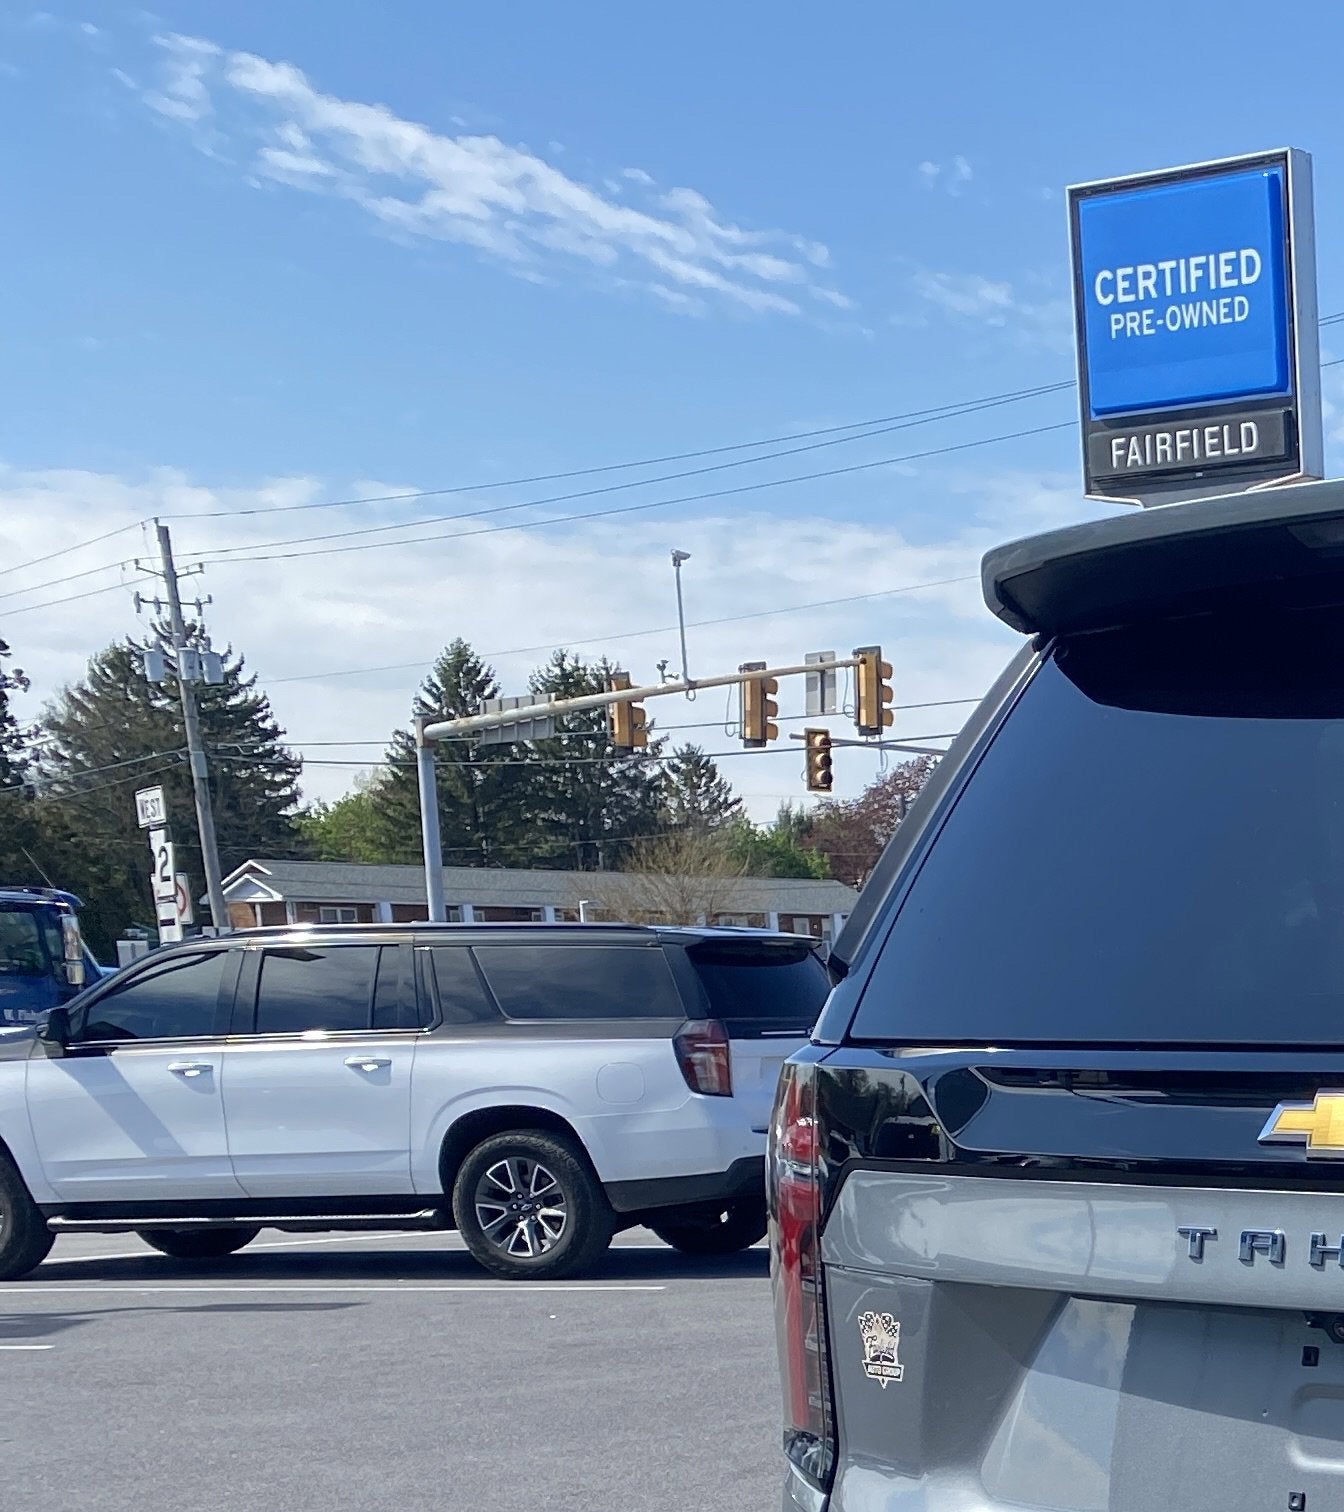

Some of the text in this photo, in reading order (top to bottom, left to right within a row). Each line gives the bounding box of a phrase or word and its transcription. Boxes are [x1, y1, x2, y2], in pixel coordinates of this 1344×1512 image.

[1095, 248, 1262, 306] CERTIFIED
[1110, 295, 1249, 340] PRE-OWNED
[1110, 421, 1259, 469] FAIRFIELD
